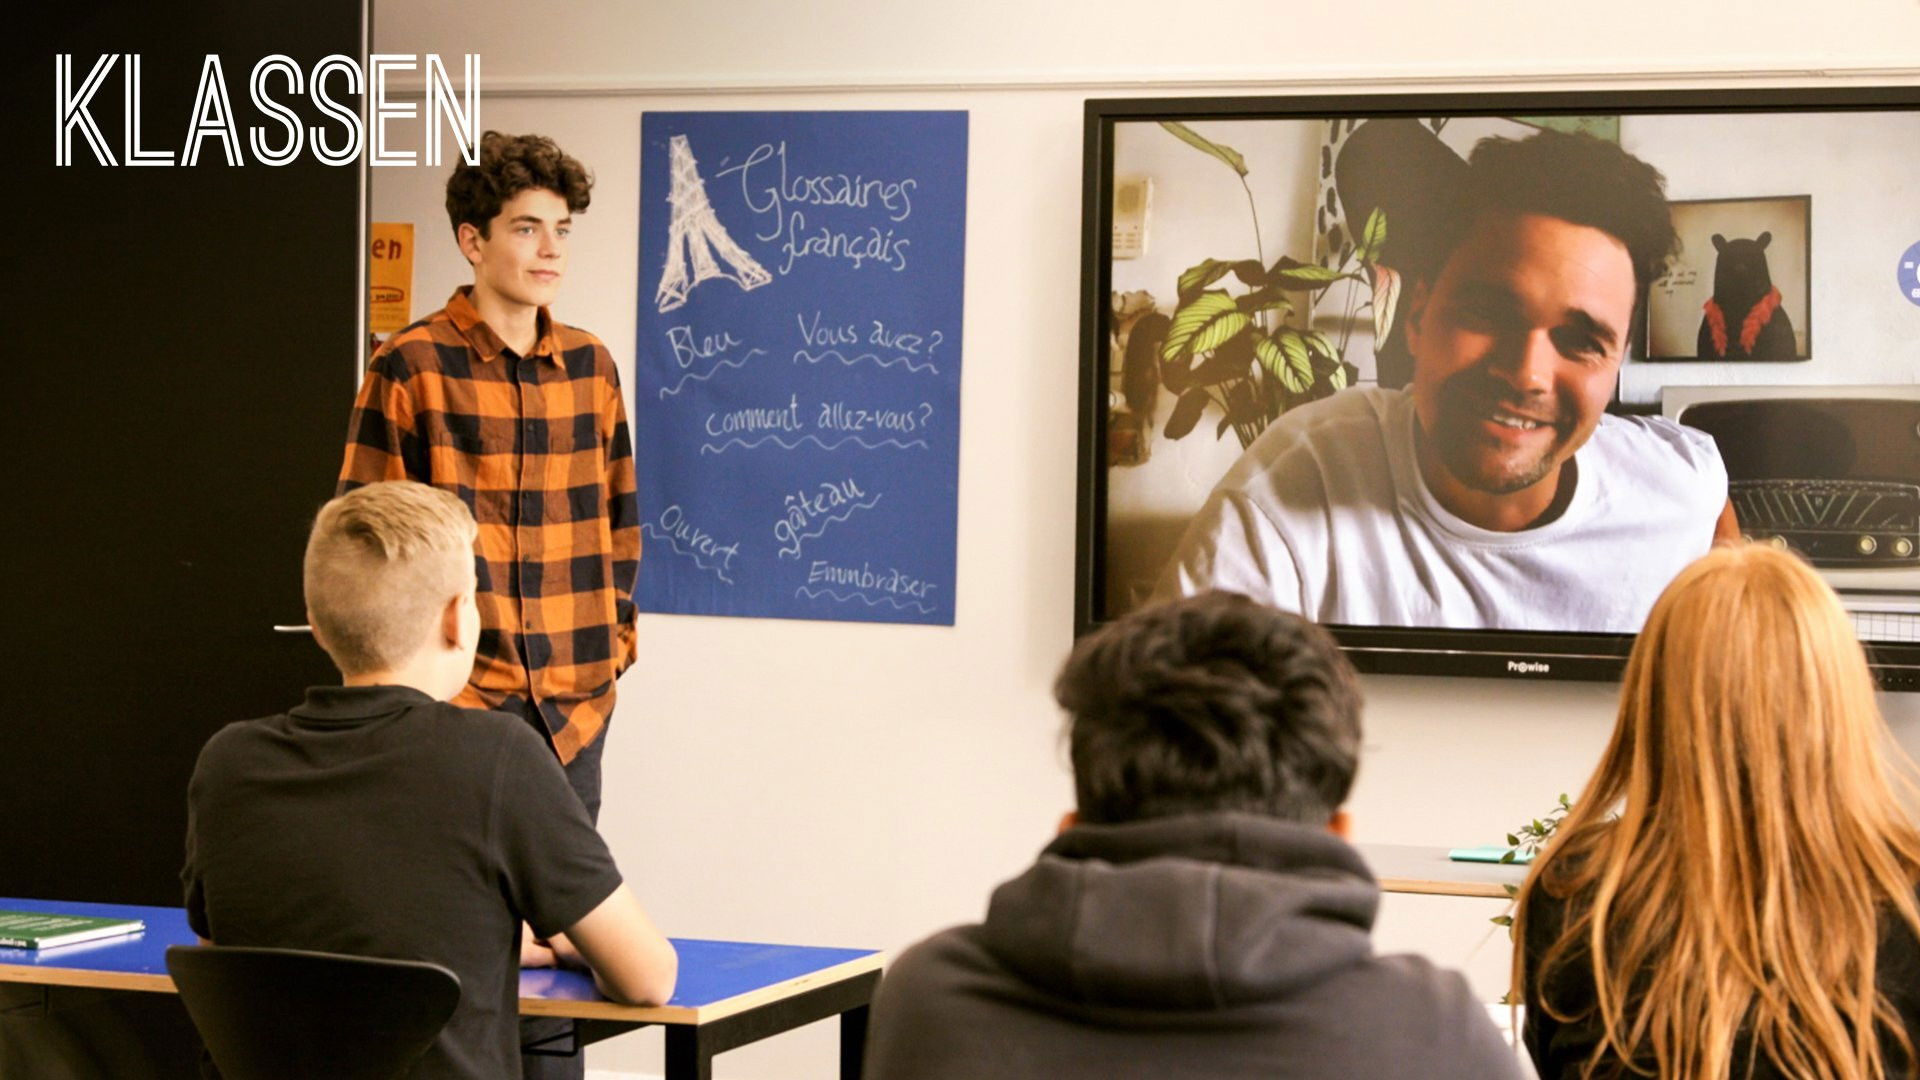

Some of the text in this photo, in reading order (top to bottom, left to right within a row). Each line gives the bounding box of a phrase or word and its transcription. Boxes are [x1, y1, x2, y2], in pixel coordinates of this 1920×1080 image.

[715, 140, 917, 242] Glossaires
[778, 211, 910, 276] français
[666, 325, 743, 368] Bleu
[797, 309, 858, 346] Vous
[659, 504, 740, 571] Ouvert
[773, 477, 865, 561] gâteau
